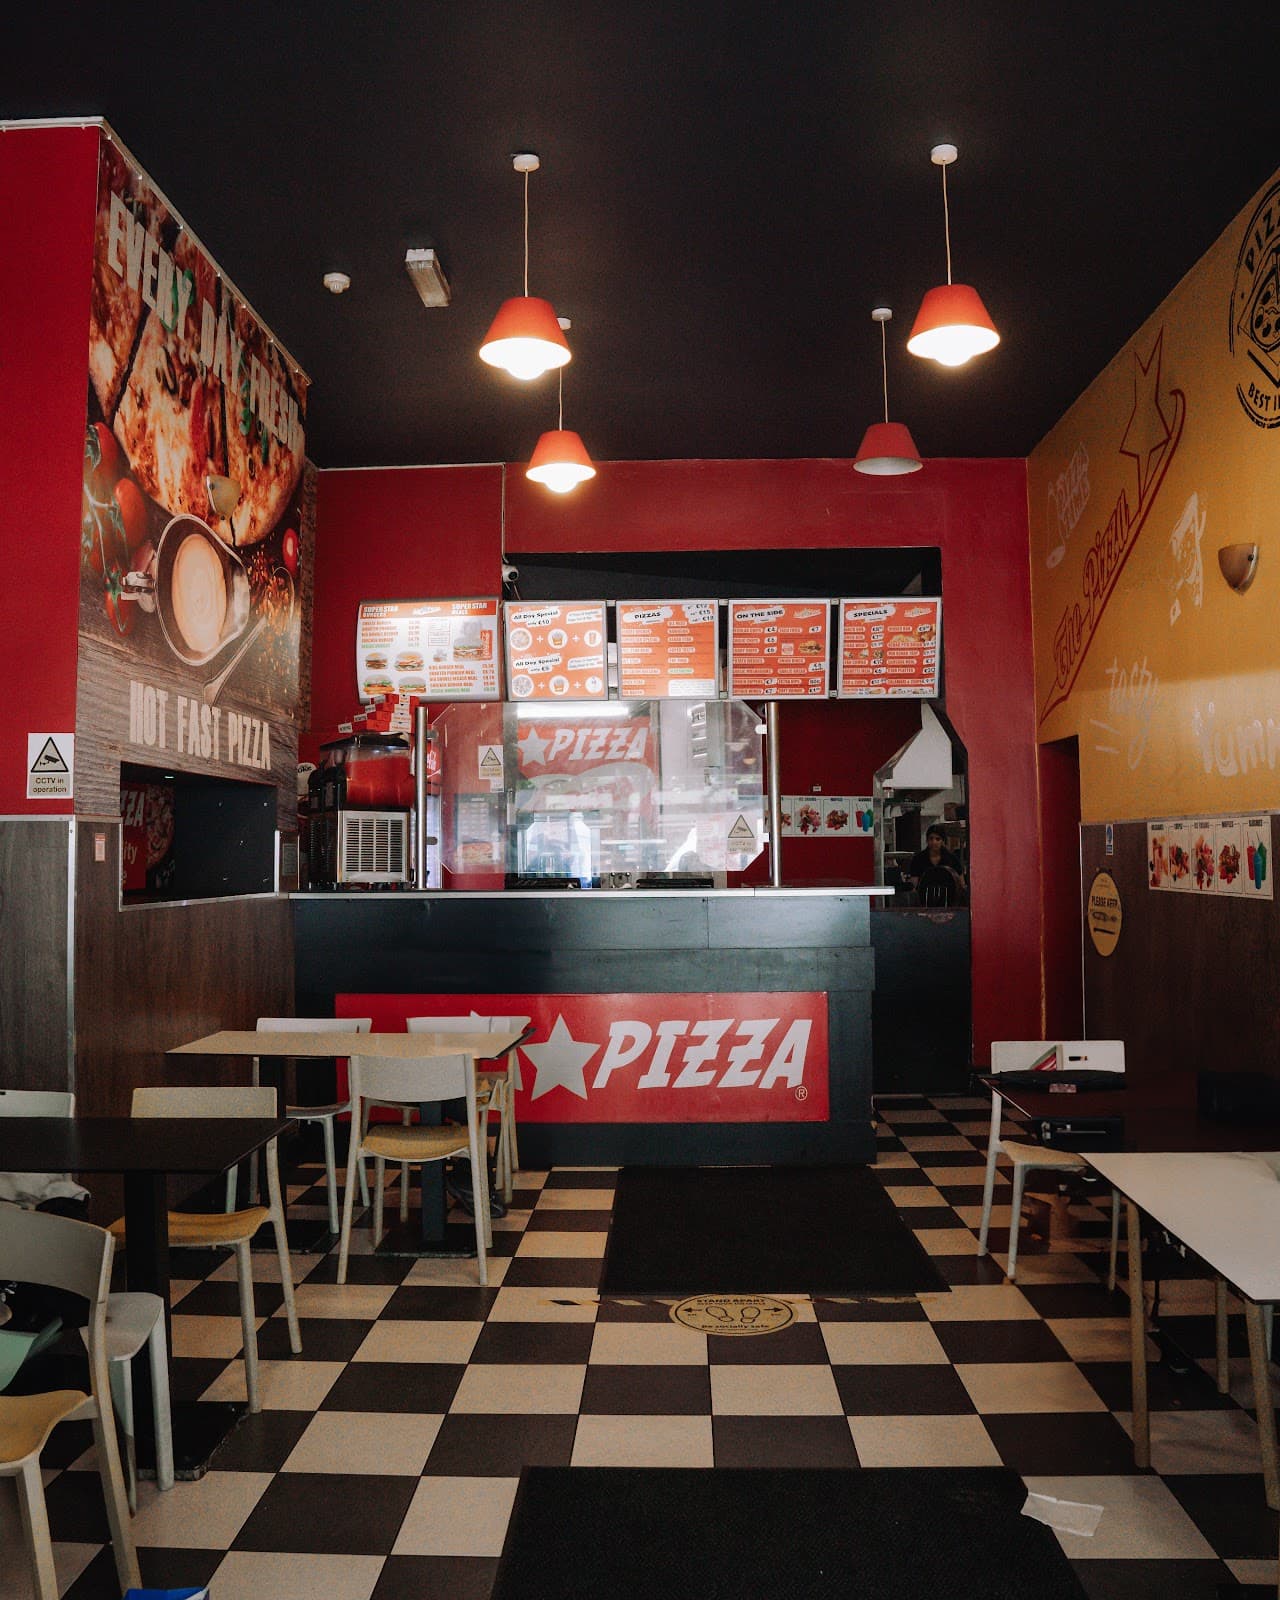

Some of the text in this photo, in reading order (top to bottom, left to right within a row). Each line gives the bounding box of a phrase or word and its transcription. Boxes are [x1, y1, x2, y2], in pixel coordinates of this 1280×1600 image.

[1244, 196, 1280, 275] PIZ
[107, 191, 304, 457] EVERY DAY FRESH
[1247, 382, 1272, 411] BEST
[634, 611, 661, 619] PIZZAS
[766, 609, 784, 617] SIDE
[853, 609, 888, 618] SPECIALS
[129, 679, 170, 749] HOT
[176, 696, 222, 761] FAST
[228, 711, 272, 770] PIZZA
[547, 727, 650, 762] PIZZA
[32, 785, 67, 795] operation
[35, 776, 65, 785] CCTV in
[123, 840, 139, 865] ity
[591, 1018, 814, 1091] PIZZA
